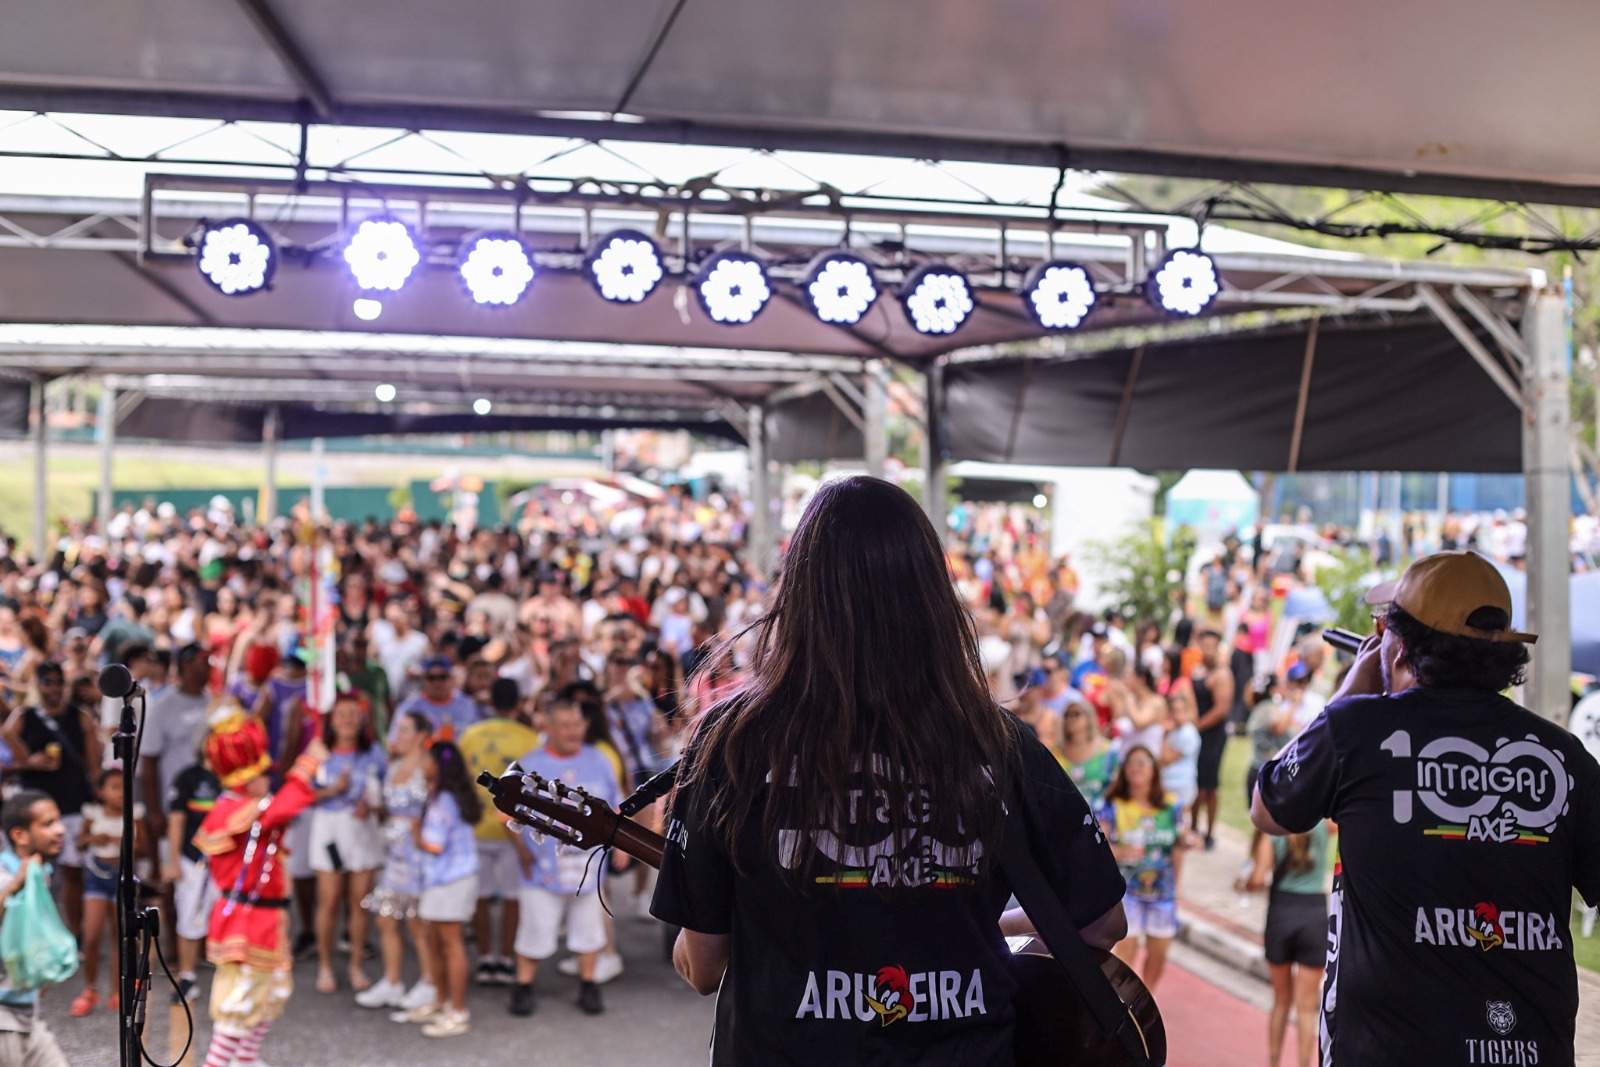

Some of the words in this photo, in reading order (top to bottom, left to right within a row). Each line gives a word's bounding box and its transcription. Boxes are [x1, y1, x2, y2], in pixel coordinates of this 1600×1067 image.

[1417, 760, 1549, 802] INTRIGAS
[1466, 810, 1519, 842] AXÉ
[1465, 1038, 1539, 1066] TIGERS
